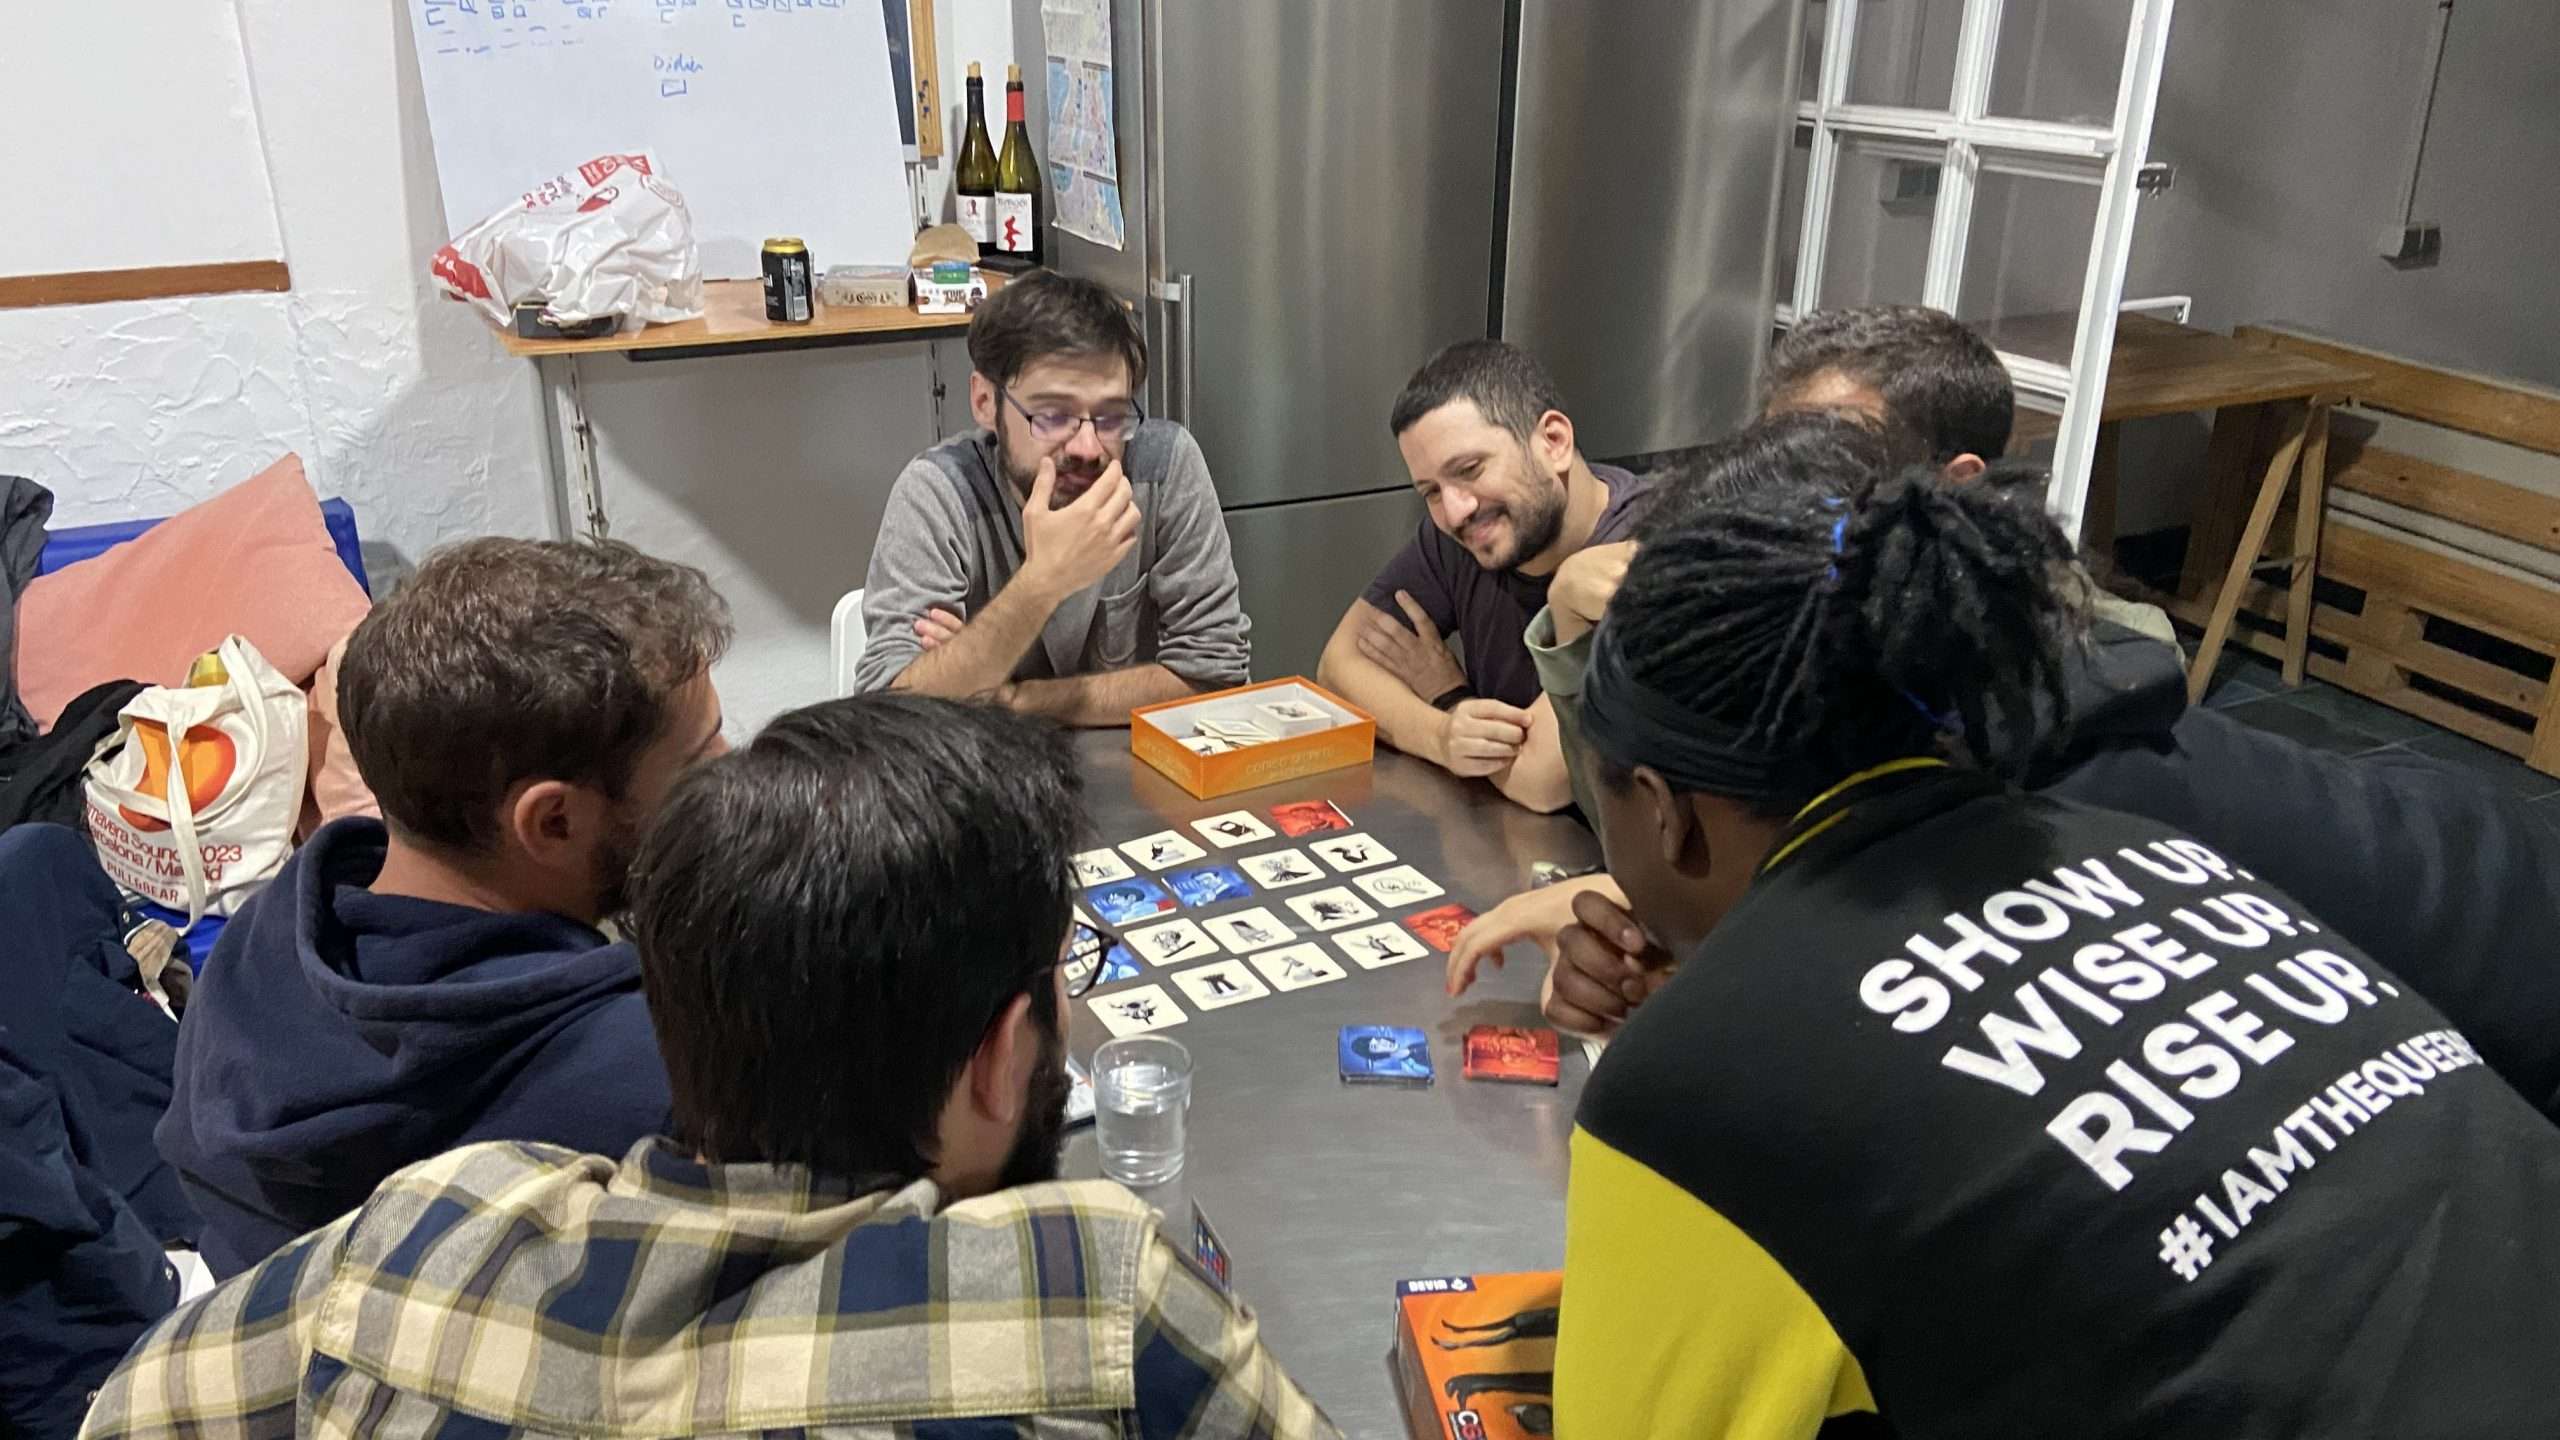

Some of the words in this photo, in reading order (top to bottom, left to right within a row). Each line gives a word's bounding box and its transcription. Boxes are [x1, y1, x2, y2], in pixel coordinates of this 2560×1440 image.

[88, 802, 129, 844] mavera
[199, 843, 242, 865] 023
[91, 825, 143, 868] arcelona
[1859, 857, 2145, 1033] SHOW
[1941, 922, 2218, 1096] WISE
[2045, 990, 2296, 1192] RISE
